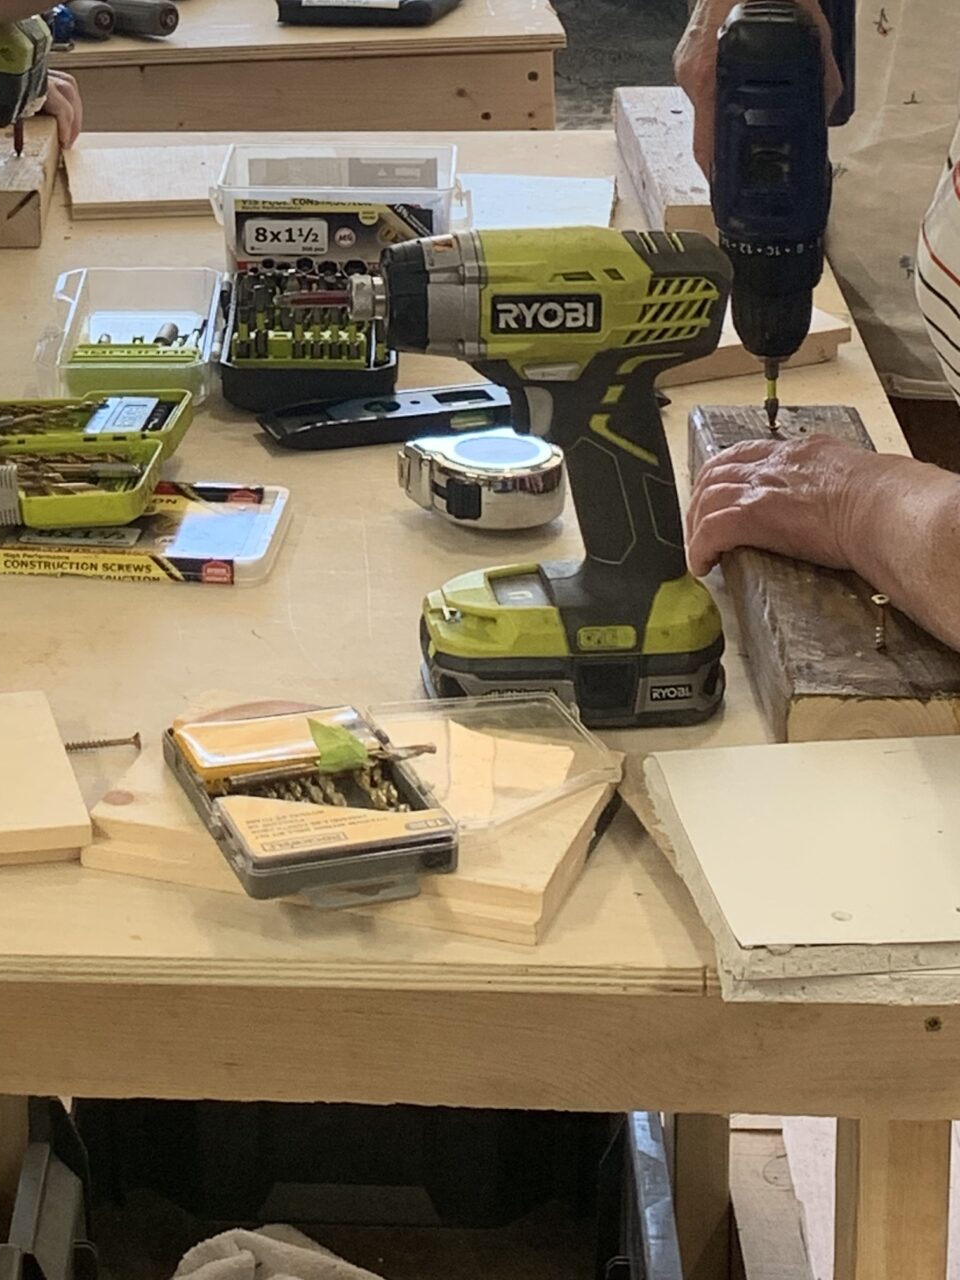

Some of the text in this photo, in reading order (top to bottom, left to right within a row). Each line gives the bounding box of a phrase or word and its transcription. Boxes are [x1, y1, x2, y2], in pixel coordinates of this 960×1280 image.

[495, 301, 595, 330] RYOBI
[3, 558, 153, 574] CONSTRUCTION SCREWS
[651, 686, 690, 700] RYOBI
